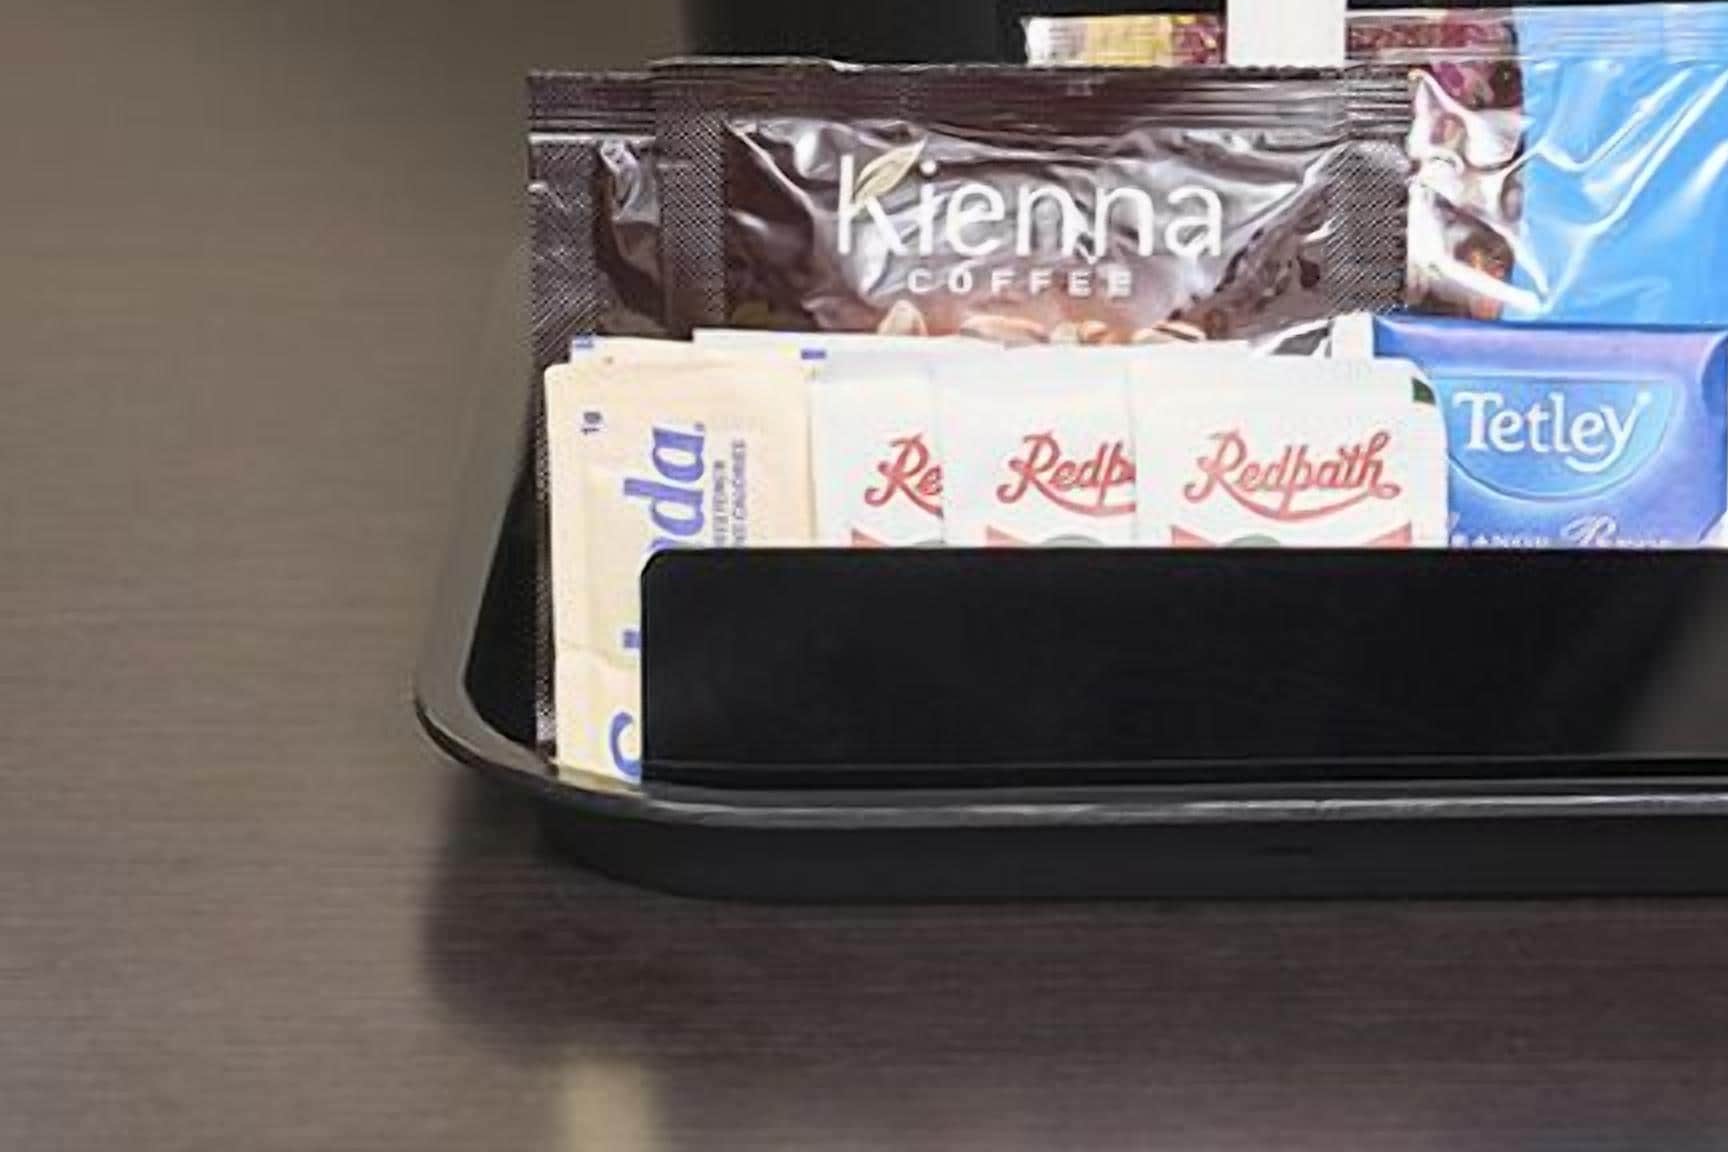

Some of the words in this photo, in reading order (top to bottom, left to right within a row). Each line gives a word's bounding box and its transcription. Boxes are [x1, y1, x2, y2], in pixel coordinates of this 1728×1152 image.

[907, 268, 1132, 297] COFFEE
[1451, 390, 1652, 473] Tetley
[1185, 431, 1402, 520] Redpath
